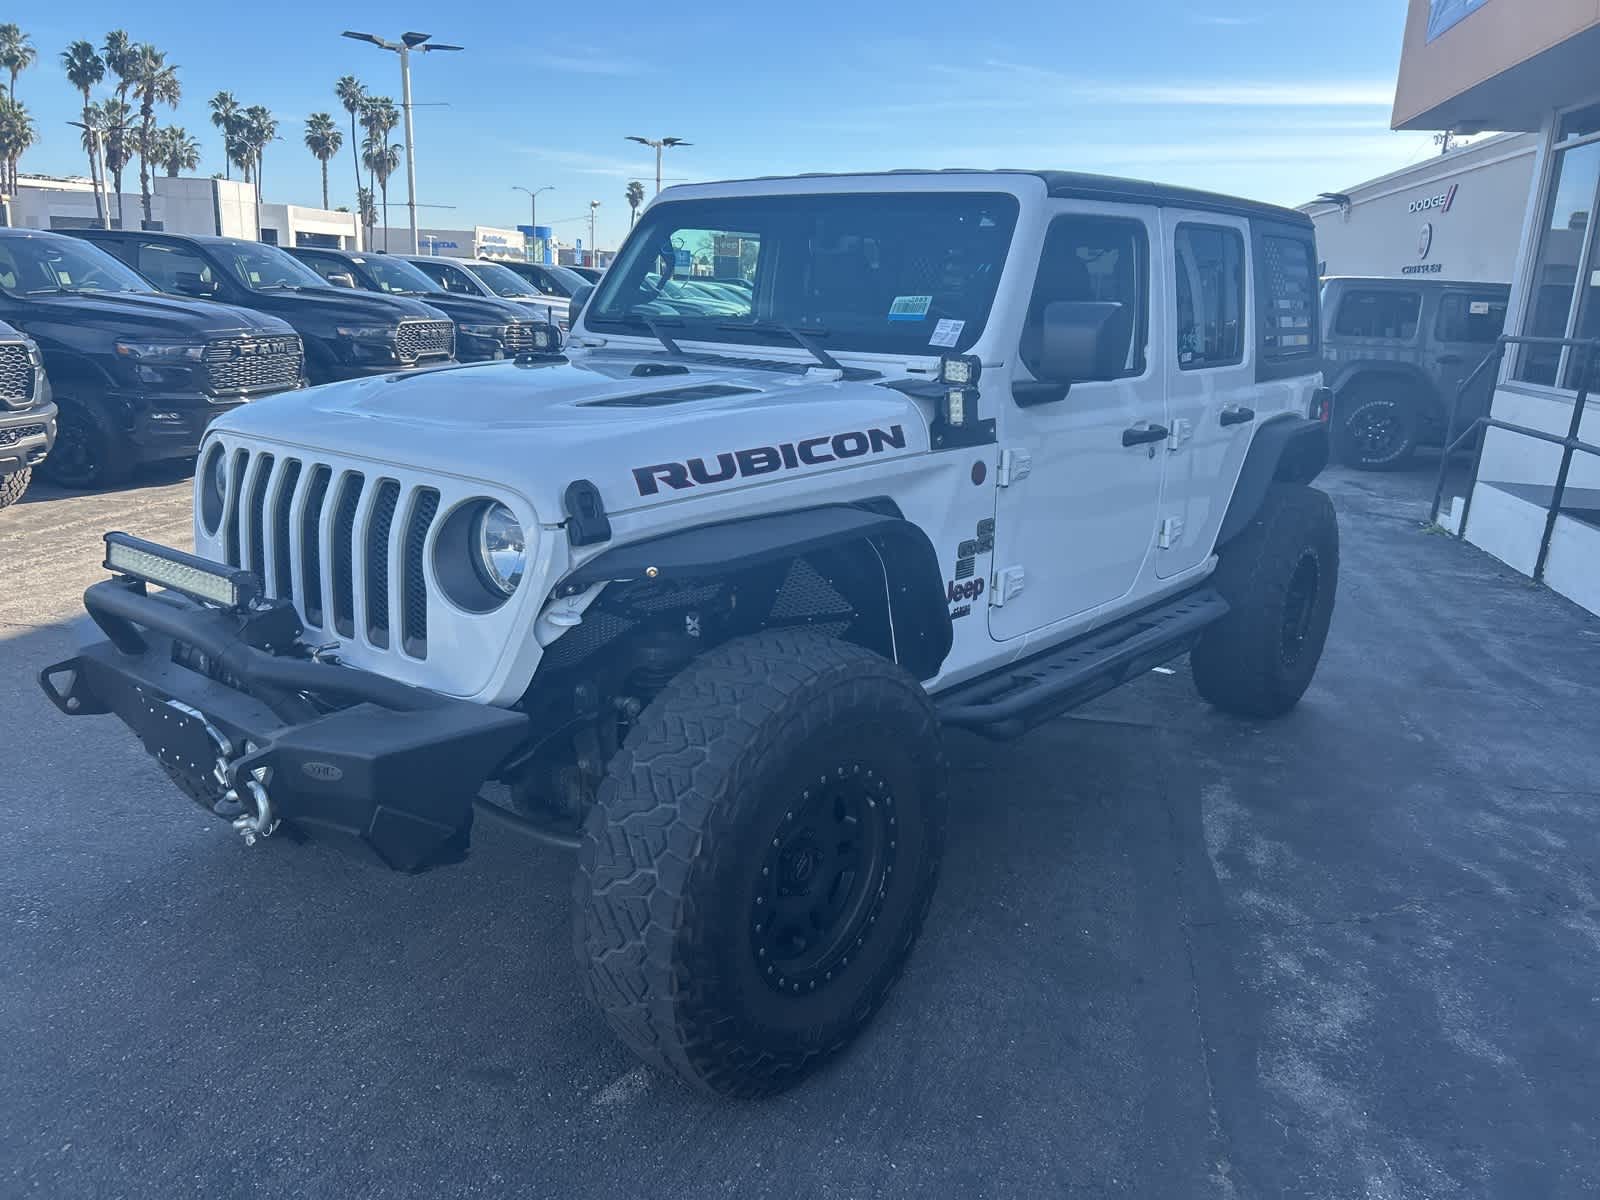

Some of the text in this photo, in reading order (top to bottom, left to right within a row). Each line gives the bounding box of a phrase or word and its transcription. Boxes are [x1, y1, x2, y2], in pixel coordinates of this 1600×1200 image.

[1408, 194, 1446, 213] DODGE
[239, 343, 286, 355] RAM
[632, 424, 906, 497] RUBICON
[946, 577, 985, 602] Jeep
